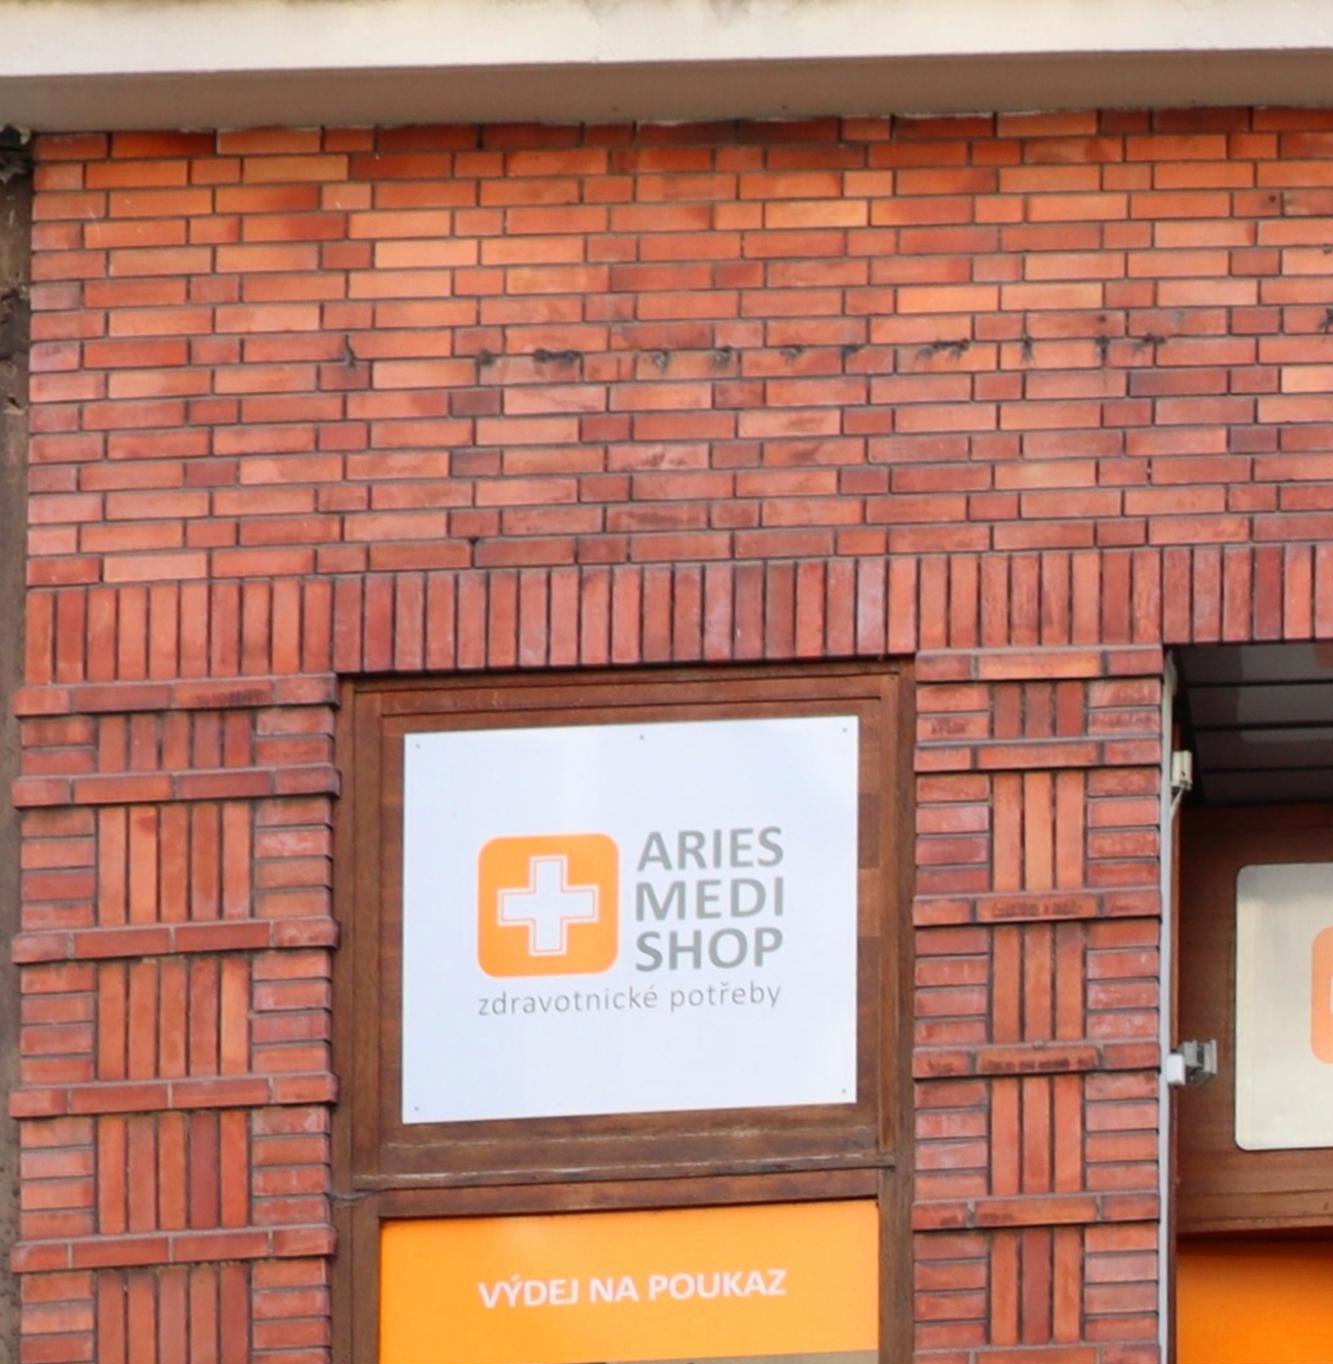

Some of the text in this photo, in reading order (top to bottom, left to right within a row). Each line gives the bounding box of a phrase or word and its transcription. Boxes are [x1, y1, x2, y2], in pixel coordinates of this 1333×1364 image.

[637, 826, 784, 872] ARIES
[635, 877, 784, 922] MEDI
[635, 927, 784, 972] SHOP
[478, 982, 782, 1016] zdravotnické potřeby
[478, 1269, 787, 1309] VÝDEJ NA POUKAZ
